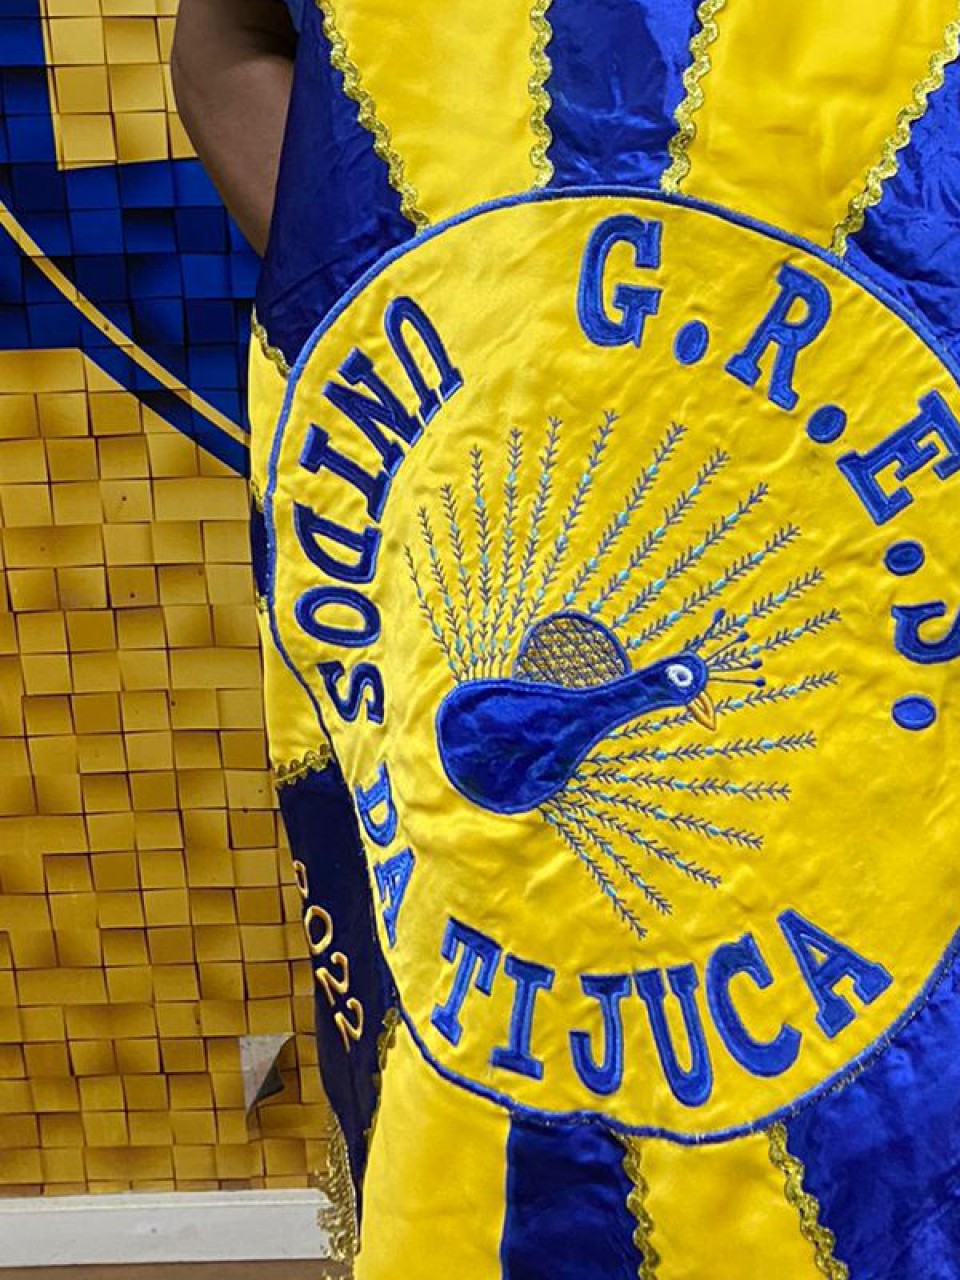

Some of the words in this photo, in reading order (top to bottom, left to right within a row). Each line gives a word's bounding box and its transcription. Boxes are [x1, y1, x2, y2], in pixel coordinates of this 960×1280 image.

[294, 295, 465, 725] UNIDOS
[354, 759, 416, 949] DA
[429, 908, 894, 1108] TIJUCA
